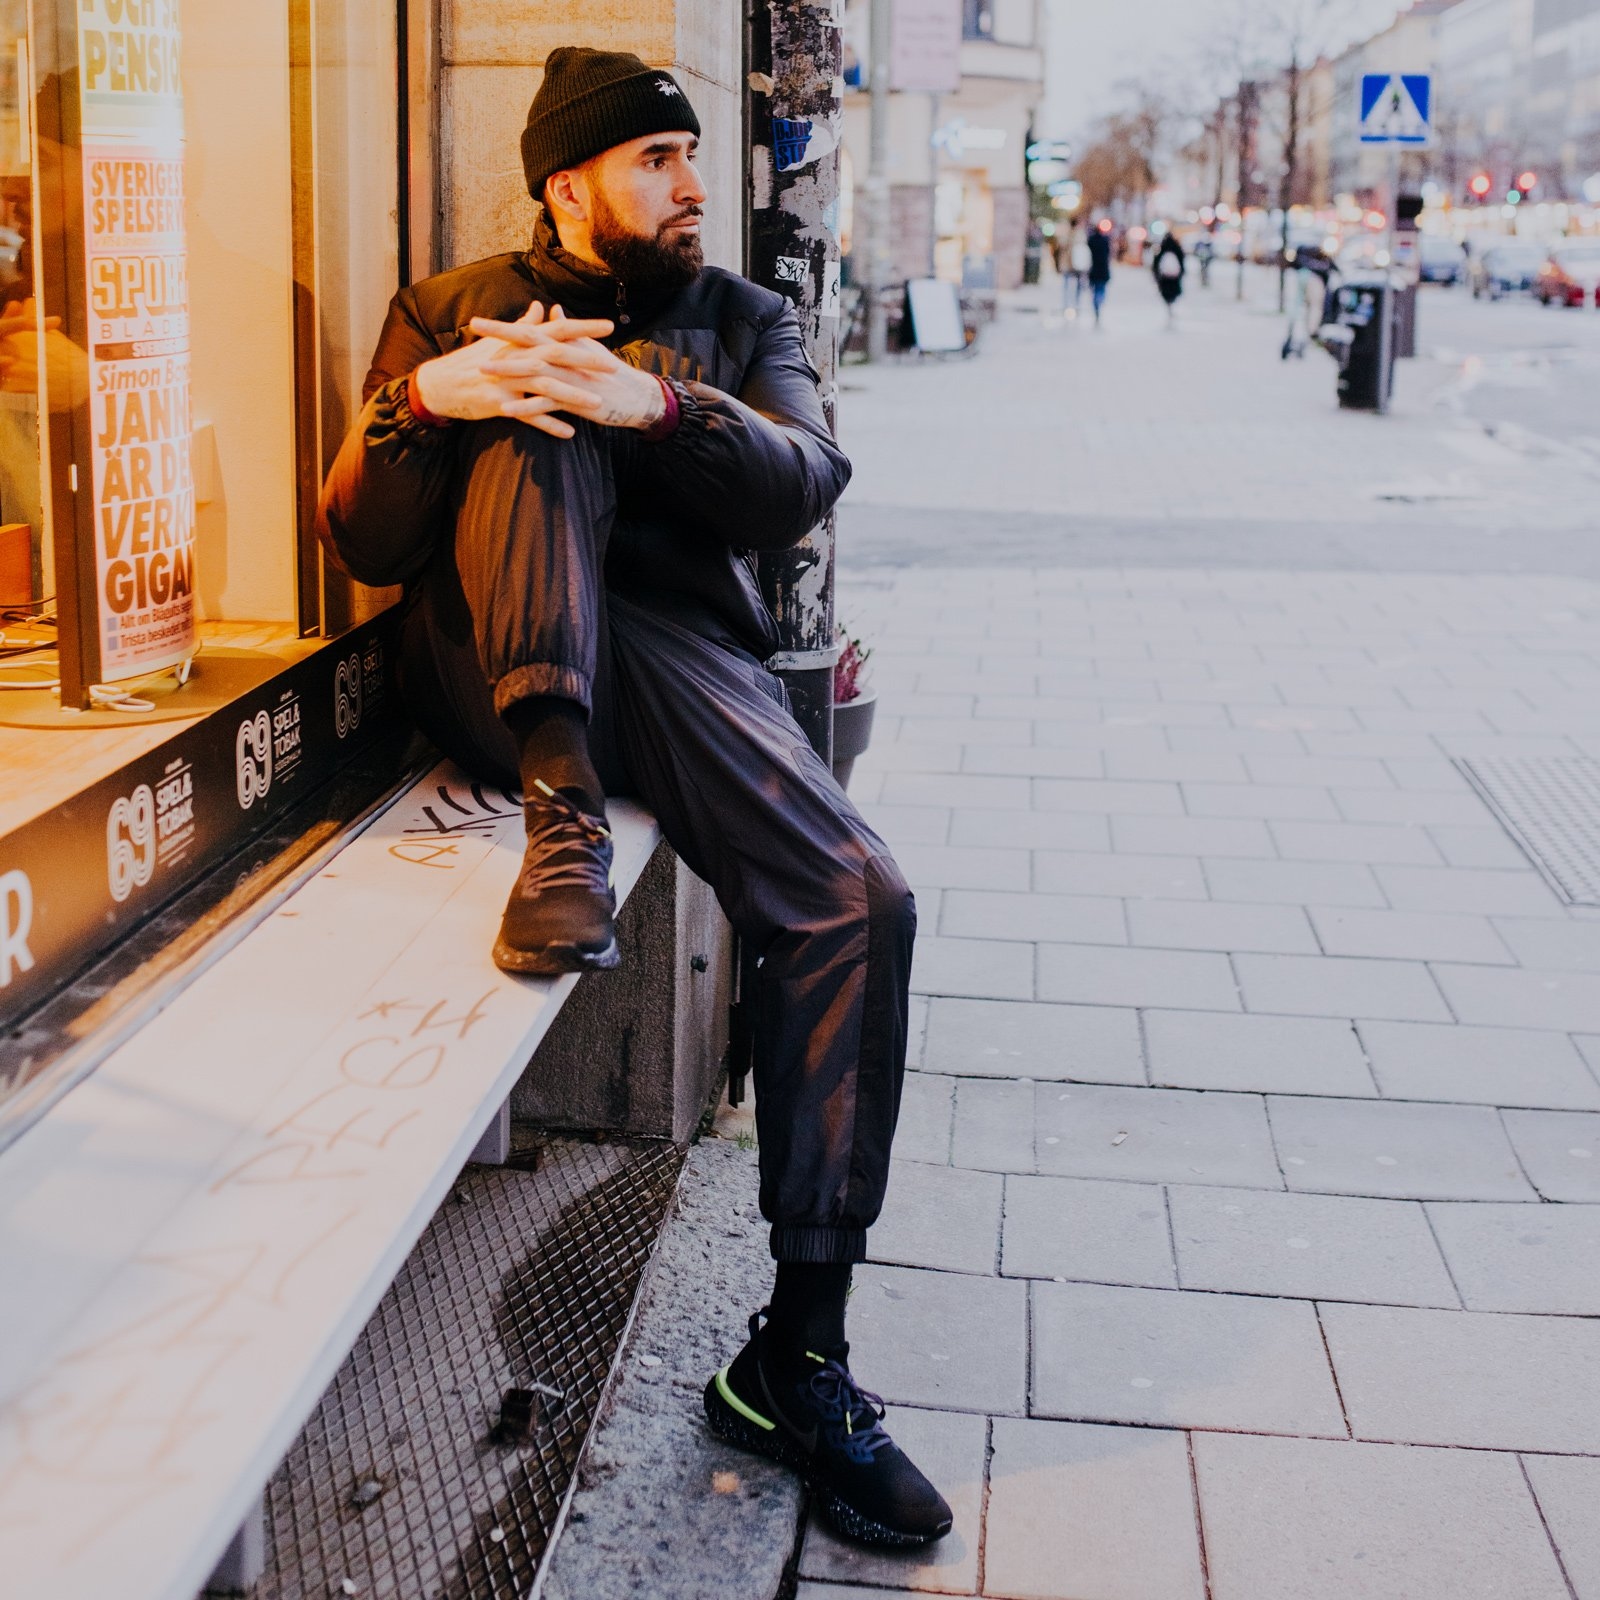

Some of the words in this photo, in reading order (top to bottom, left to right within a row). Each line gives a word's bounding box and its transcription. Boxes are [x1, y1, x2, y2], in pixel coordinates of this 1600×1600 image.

[97, 364, 161, 392] Simon
[101, 446, 155, 505] ÄR
[335, 653, 361, 739] 69
[236, 709, 273, 810] 69
[273, 725, 302, 758] TOBAK
[106, 783, 156, 902] 69
[156, 798, 194, 839] TOBAK
